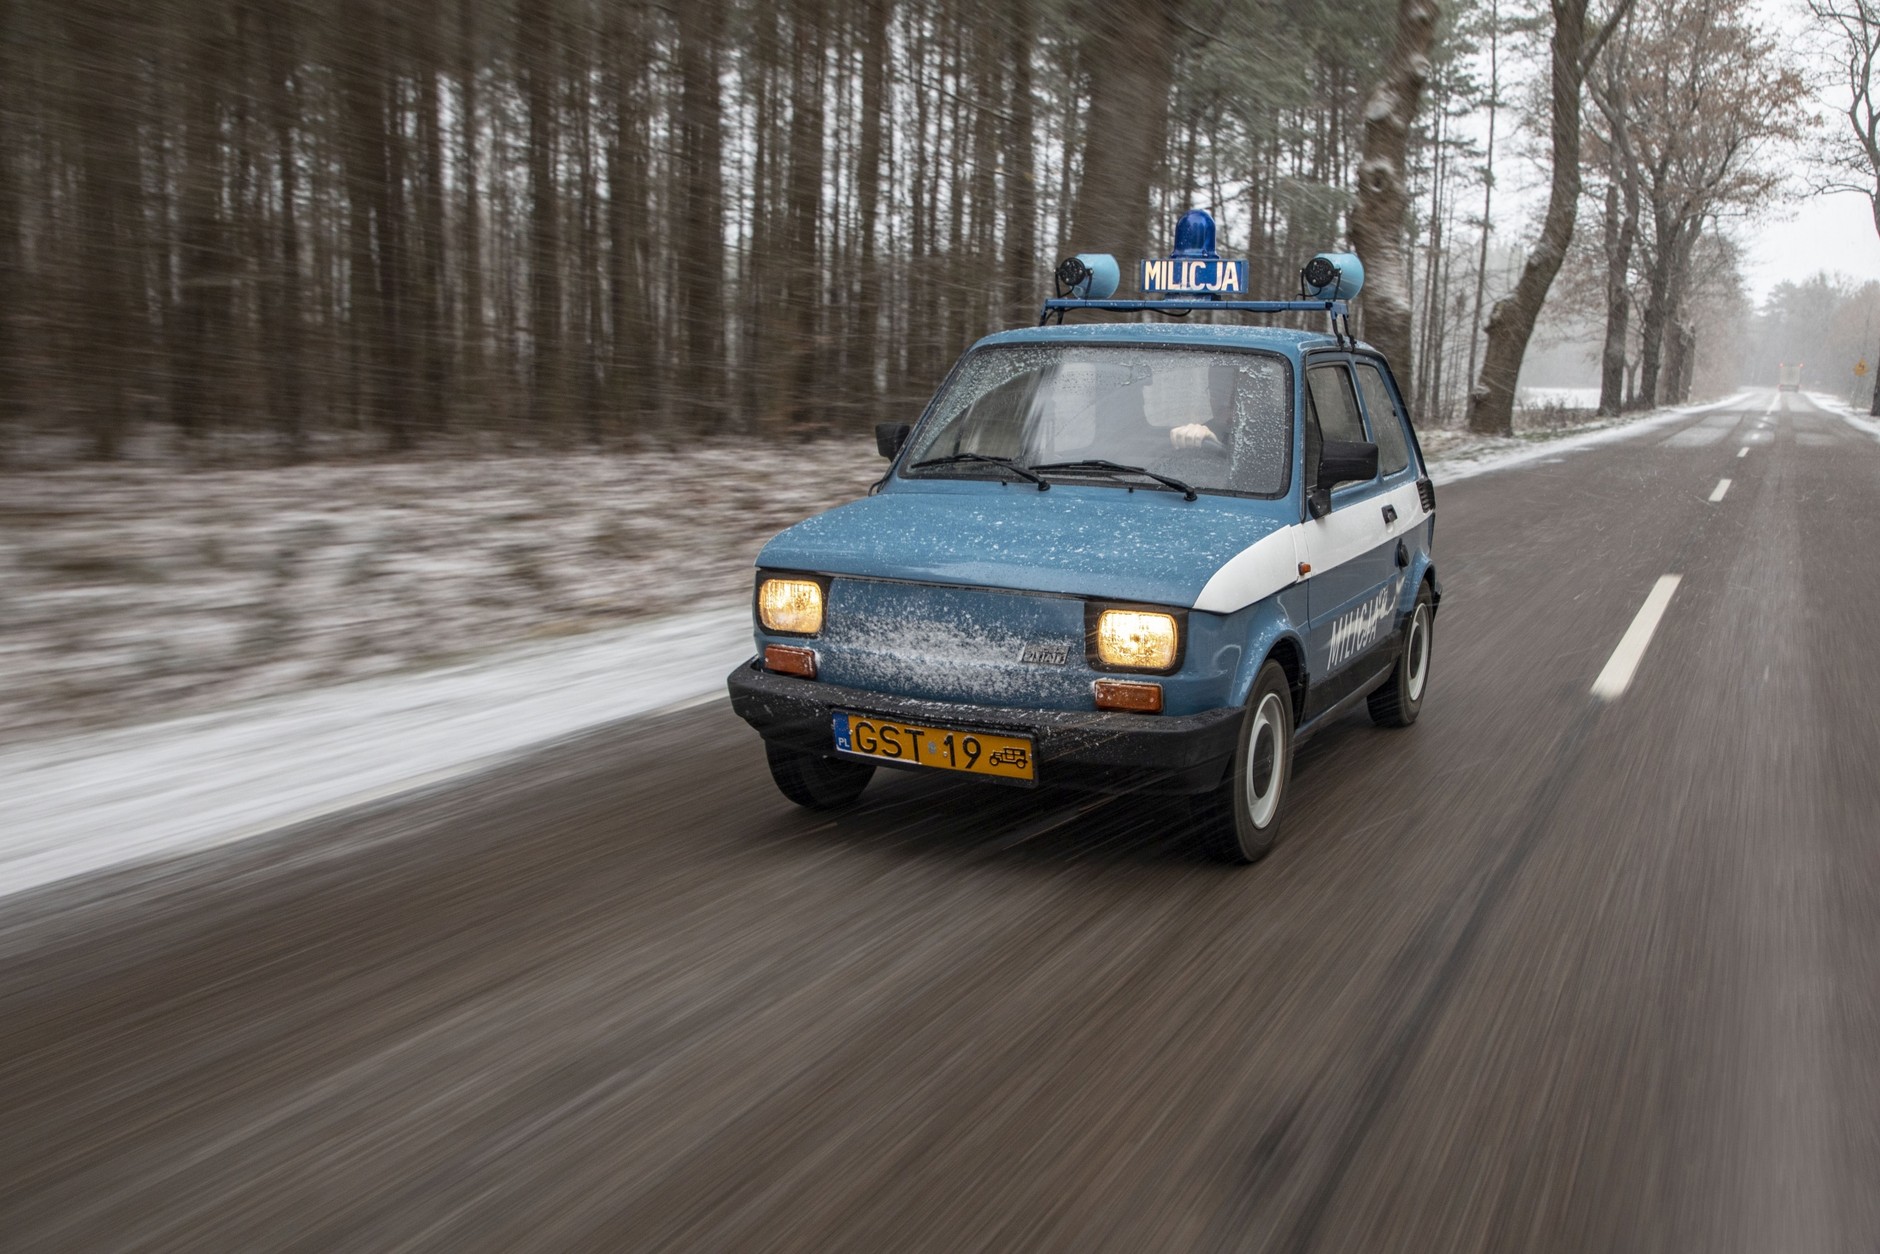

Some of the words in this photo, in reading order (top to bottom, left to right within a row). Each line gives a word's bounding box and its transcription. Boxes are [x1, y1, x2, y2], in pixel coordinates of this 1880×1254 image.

[1144, 261, 1240, 291] MILICJA
[838, 738, 850, 748] PL
[855, 721, 925, 763] GST
[943, 732, 982, 769] 19
